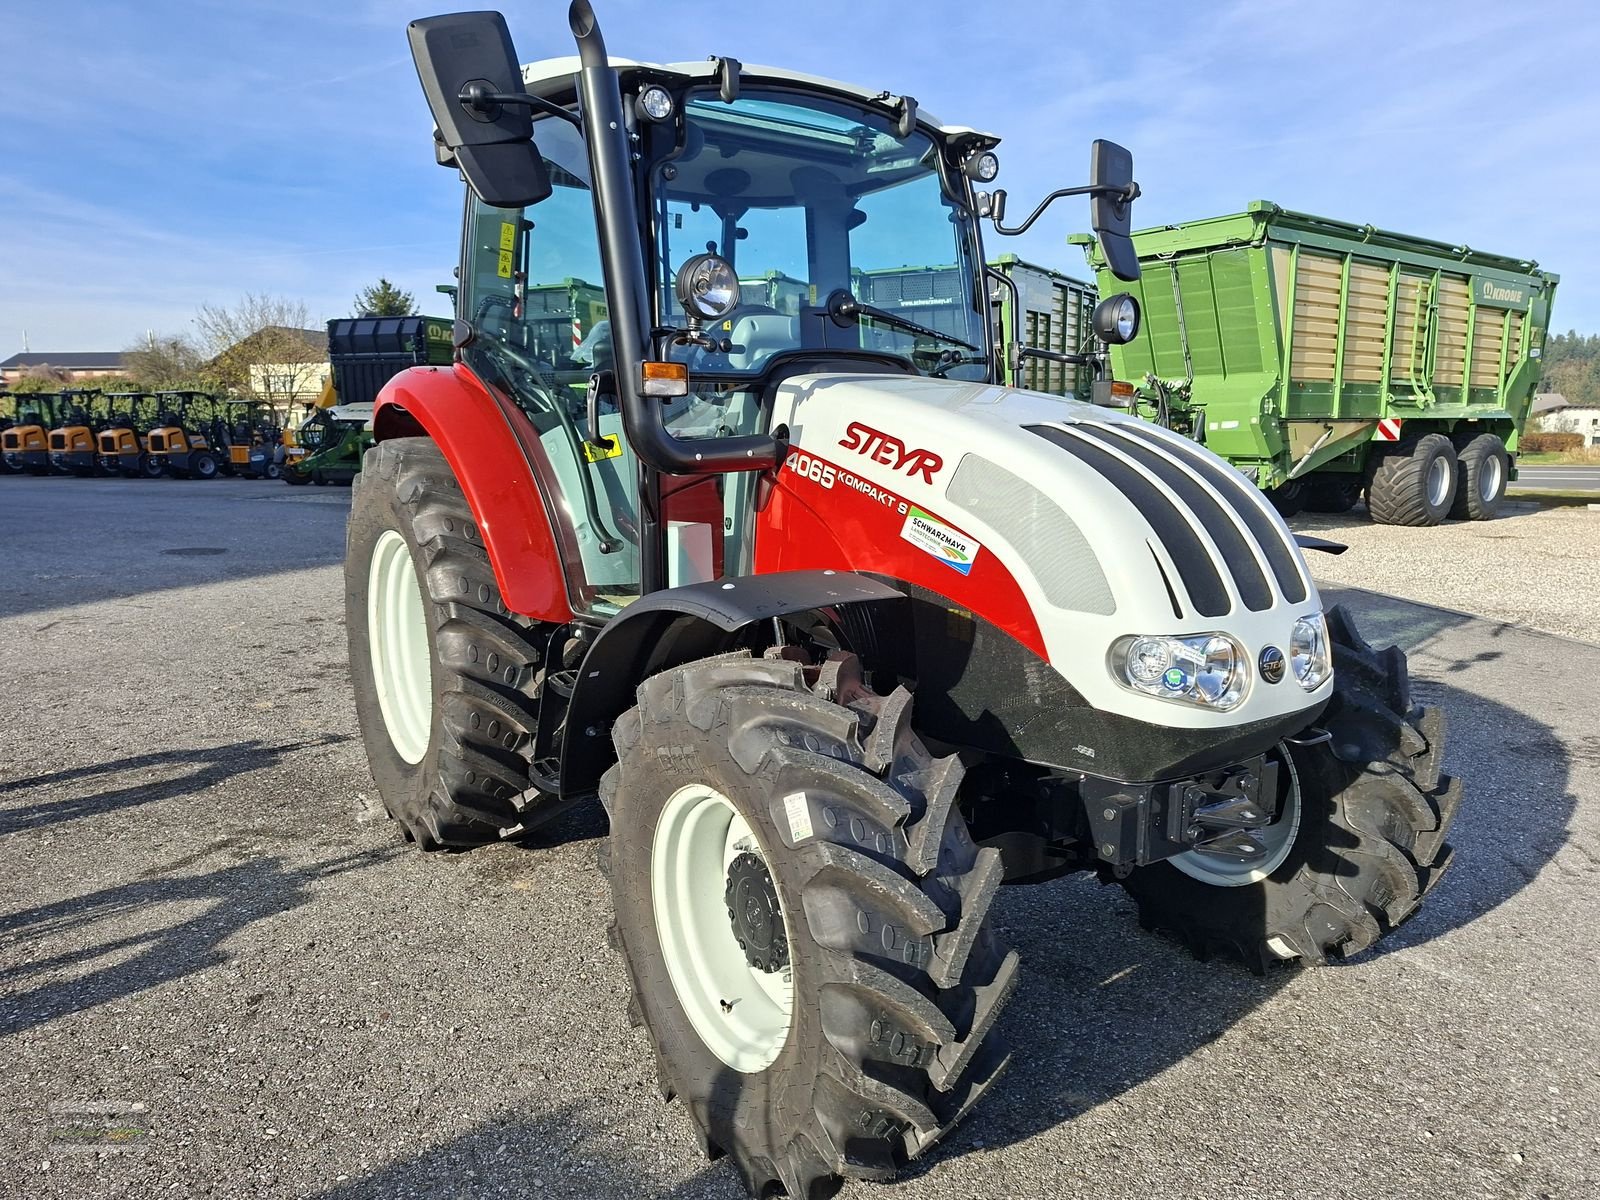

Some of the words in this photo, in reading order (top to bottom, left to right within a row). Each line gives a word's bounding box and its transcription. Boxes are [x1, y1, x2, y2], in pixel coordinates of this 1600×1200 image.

[1492, 287, 1523, 303] KRONE
[838, 421, 944, 486] STEYR
[785, 452, 837, 490] 4065
[837, 470, 896, 509] KOMPAKT
[896, 501, 909, 516] S
[912, 517, 967, 553] SCHWARZMAYR
